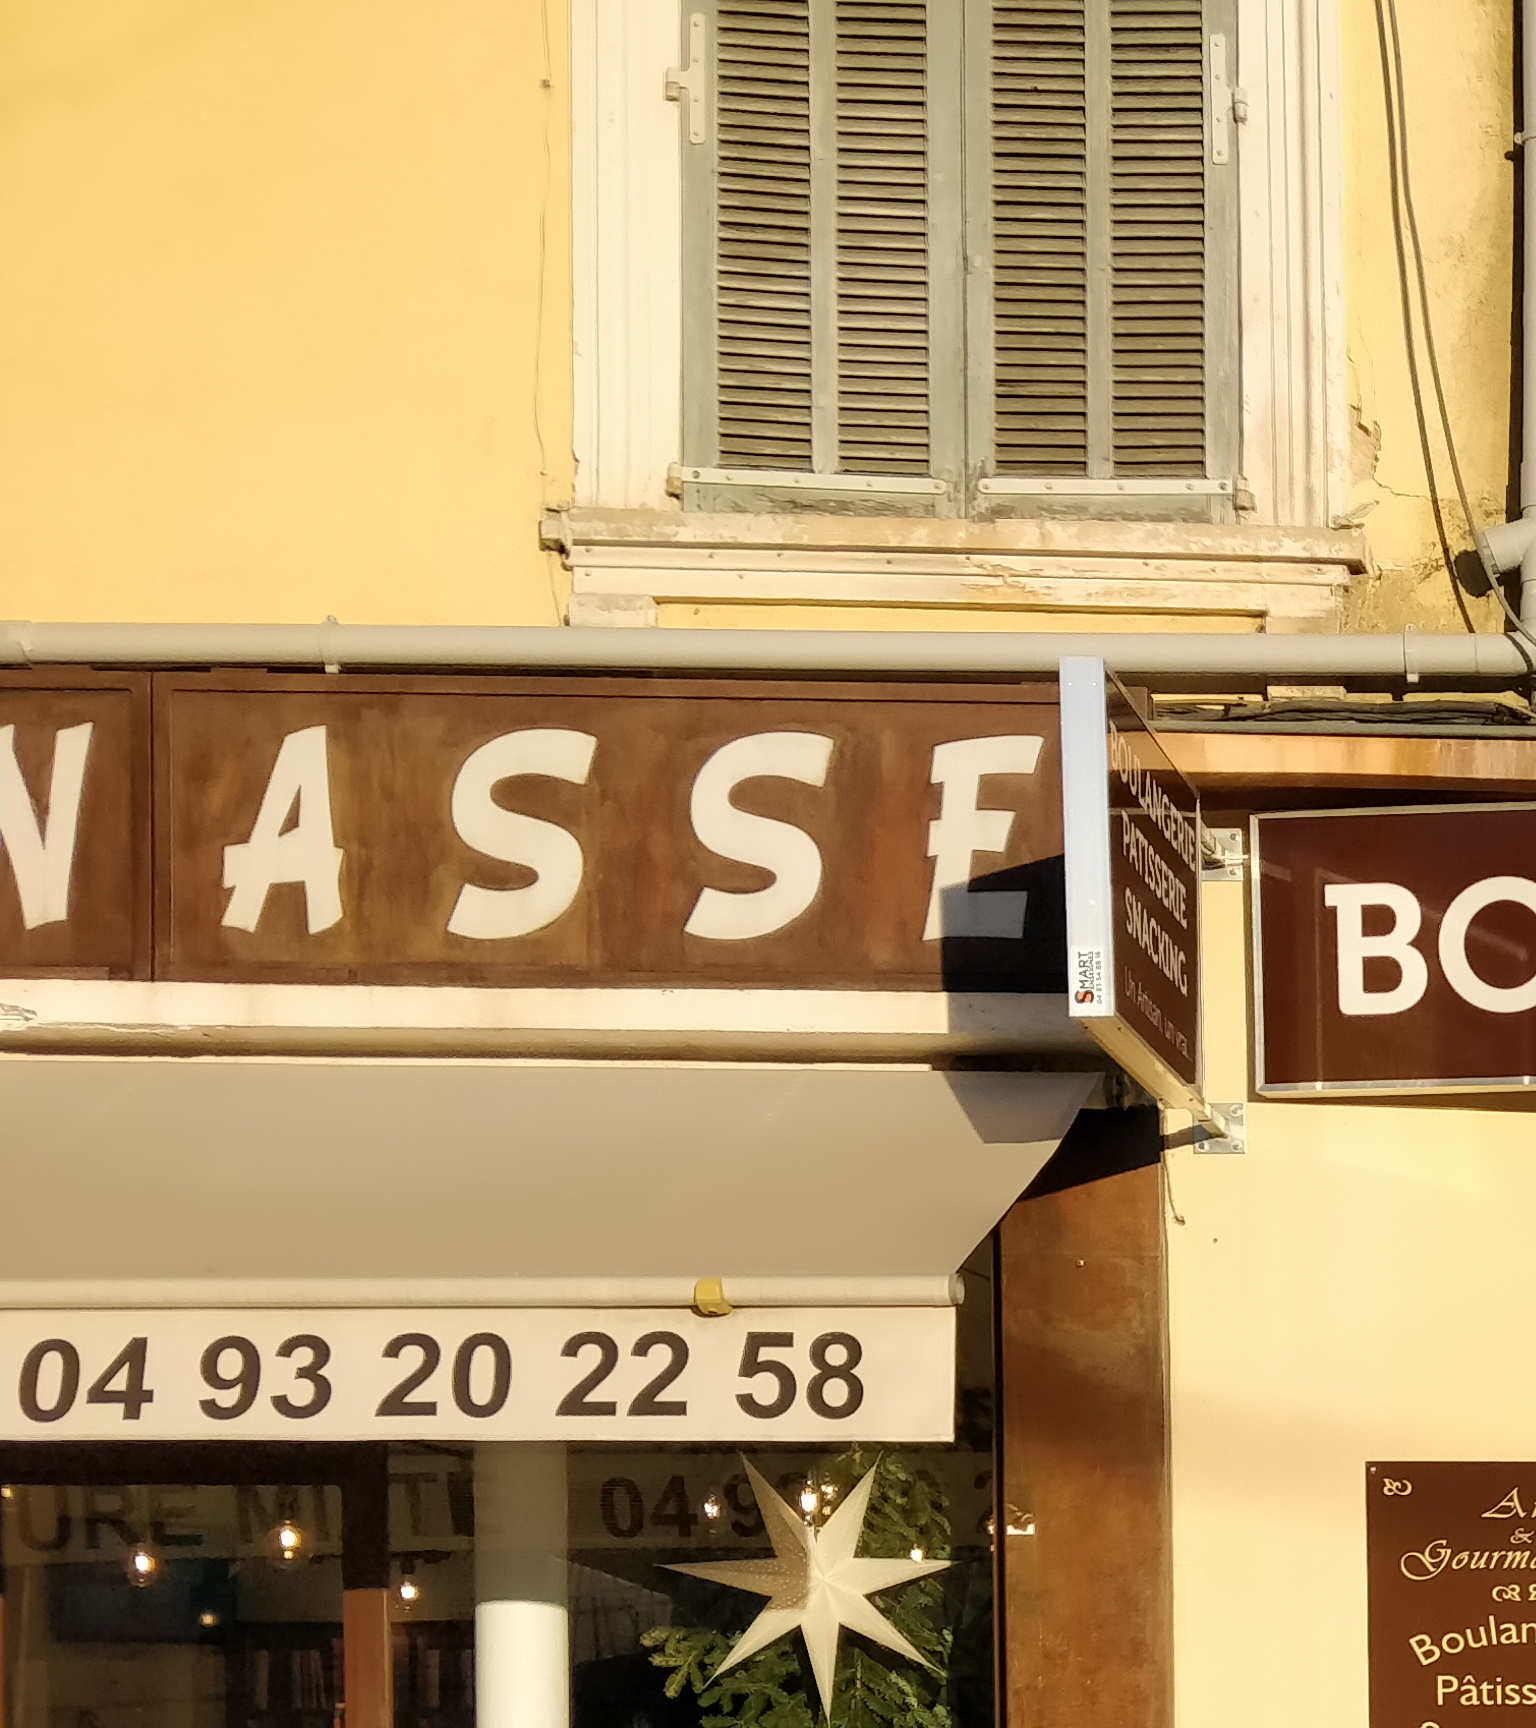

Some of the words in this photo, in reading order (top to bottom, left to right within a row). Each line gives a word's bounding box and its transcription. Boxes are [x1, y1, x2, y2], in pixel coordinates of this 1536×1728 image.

[1109, 720, 1196, 872] BOULANGERIE
[1122, 810, 1187, 929] PATISSERIE
[1125, 887, 1188, 997] SNACKING
[18, 1336, 154, 1422] 04
[199, 1333, 331, 1420] 93
[375, 1332, 512, 1417] 20
[555, 1331, 690, 1416] 22
[735, 1331, 864, 1418] 58
[1510, 1527, 1535, 1543] &
